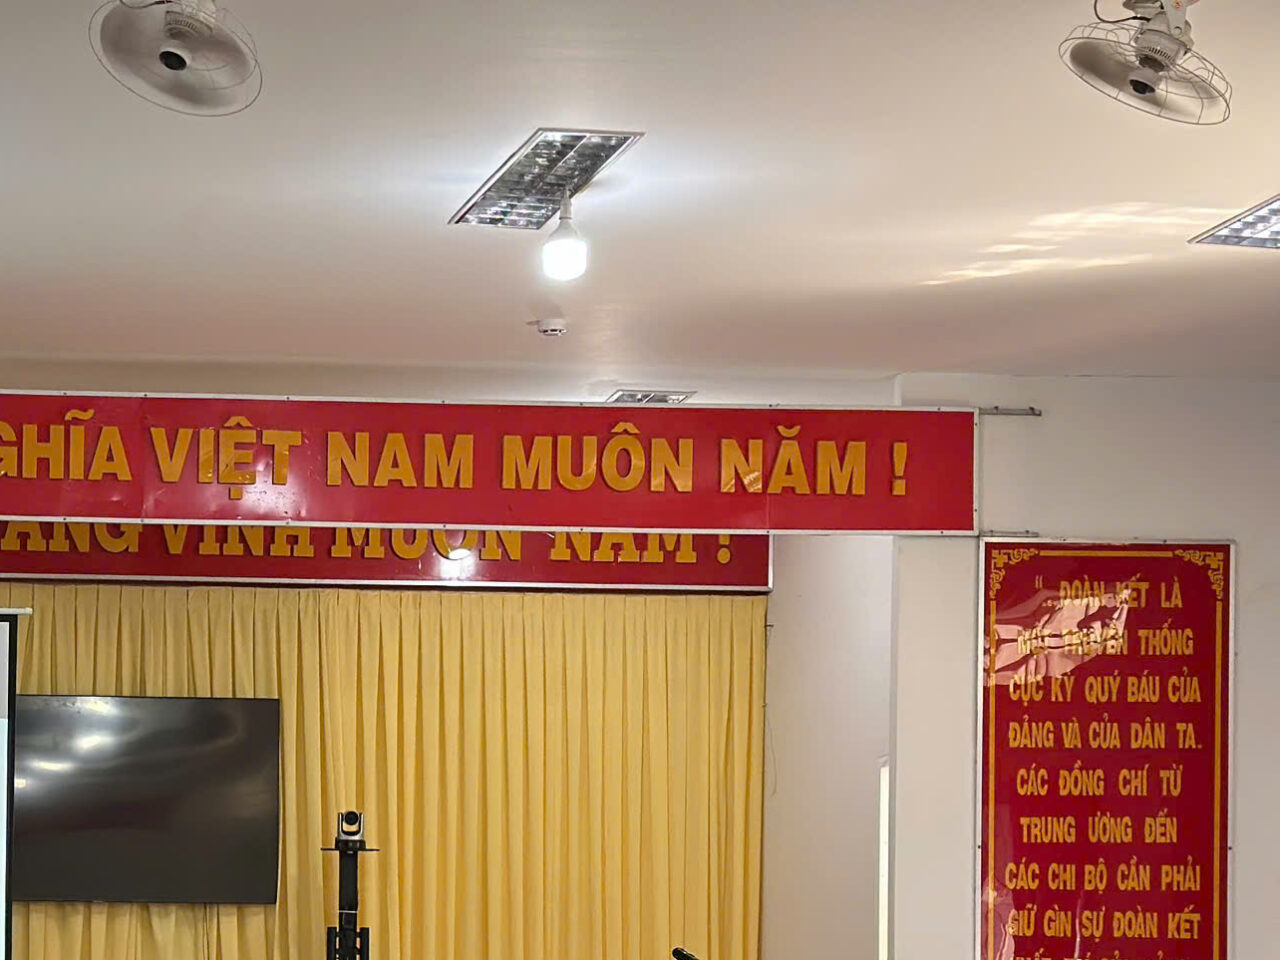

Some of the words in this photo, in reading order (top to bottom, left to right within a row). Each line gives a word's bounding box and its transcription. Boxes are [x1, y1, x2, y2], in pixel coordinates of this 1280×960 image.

[150, 417, 301, 499] VIỆT
[326, 432, 475, 490] NAM
[502, 422, 695, 494] MUÔN
[720, 425, 866, 497] NĂM
[891, 441, 908, 497] !
[1160, 576, 1183, 608] LÀ
[1138, 618, 1194, 655] THỐNG
[1084, 670, 1120, 704] QUÝ
[1127, 670, 1160, 702] BÁU
[1168, 666, 1202, 702] CỦA
[1008, 714, 1054, 749] ĐẢNG
[1061, 716, 1082, 749] VÀ
[1088, 712, 1121, 749] CỦA
[1130, 716, 1165, 749] DÂN
[1016, 763, 1048, 796] CÁC
[1058, 760, 1105, 796] ĐỒNG
[1118, 763, 1150, 796] CHÍ
[1160, 763, 1184, 797] TỪ
[1019, 816, 1076, 843] TRUNG
[1088, 811, 1133, 843] ƯƠNG
[1144, 808, 1177, 843] ĐẾN
[1005, 857, 1040, 890] CÁC
[1047, 862, 1076, 890] CHI
[1084, 858, 1108, 894] BỘ
[1160, 855, 1201, 891] PHẢI
[1008, 903, 1037, 937] GIỮ
[1043, 904, 1071, 937] GÌN
[1081, 905, 1105, 942] SỰ
[1112, 905, 1158, 938] ĐOÀN
[1167, 904, 1201, 939] KẾT
